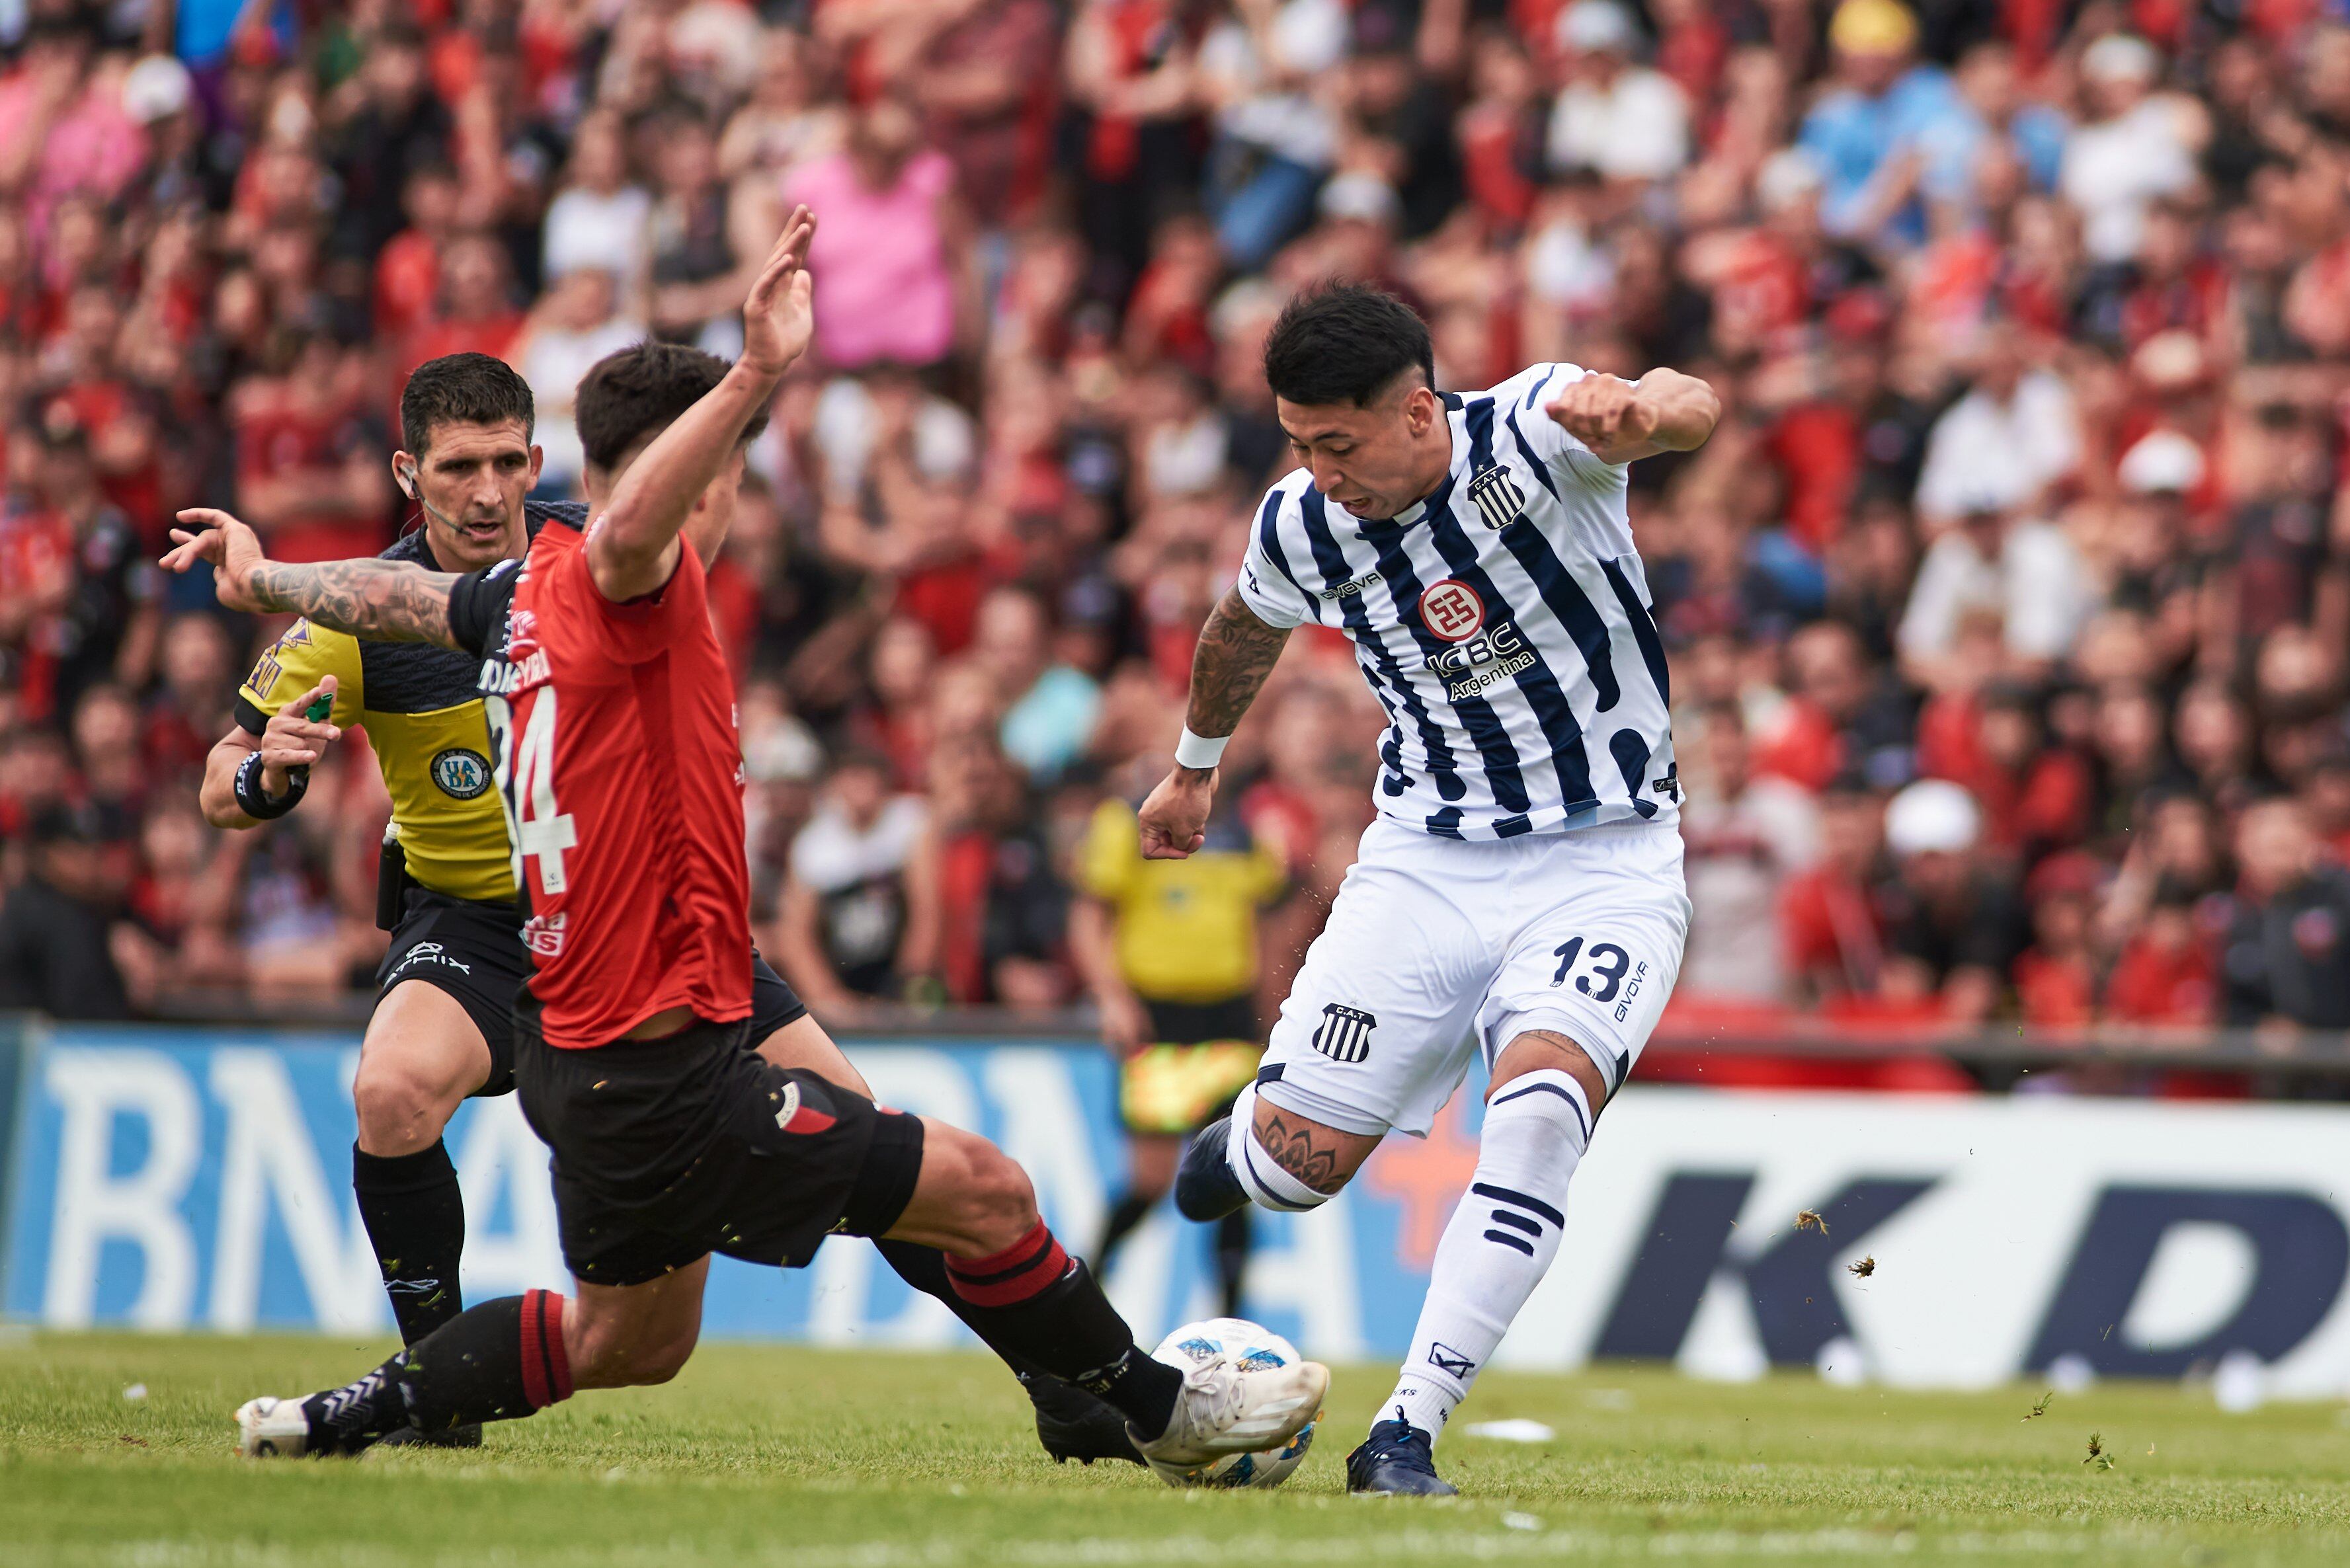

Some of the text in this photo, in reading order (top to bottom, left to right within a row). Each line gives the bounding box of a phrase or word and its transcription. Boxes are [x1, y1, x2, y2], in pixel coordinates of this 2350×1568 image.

[1319, 572, 1382, 600] GIVOVA
[1427, 621, 1522, 678] ICBC
[1449, 650, 1536, 702] Argentina
[444, 760, 475, 775] UA
[447, 773, 478, 788] DA
[1549, 936, 1630, 1003] 13
[1614, 960, 1649, 1023] GIVOVA
[43, 1050, 583, 1337] BNA
